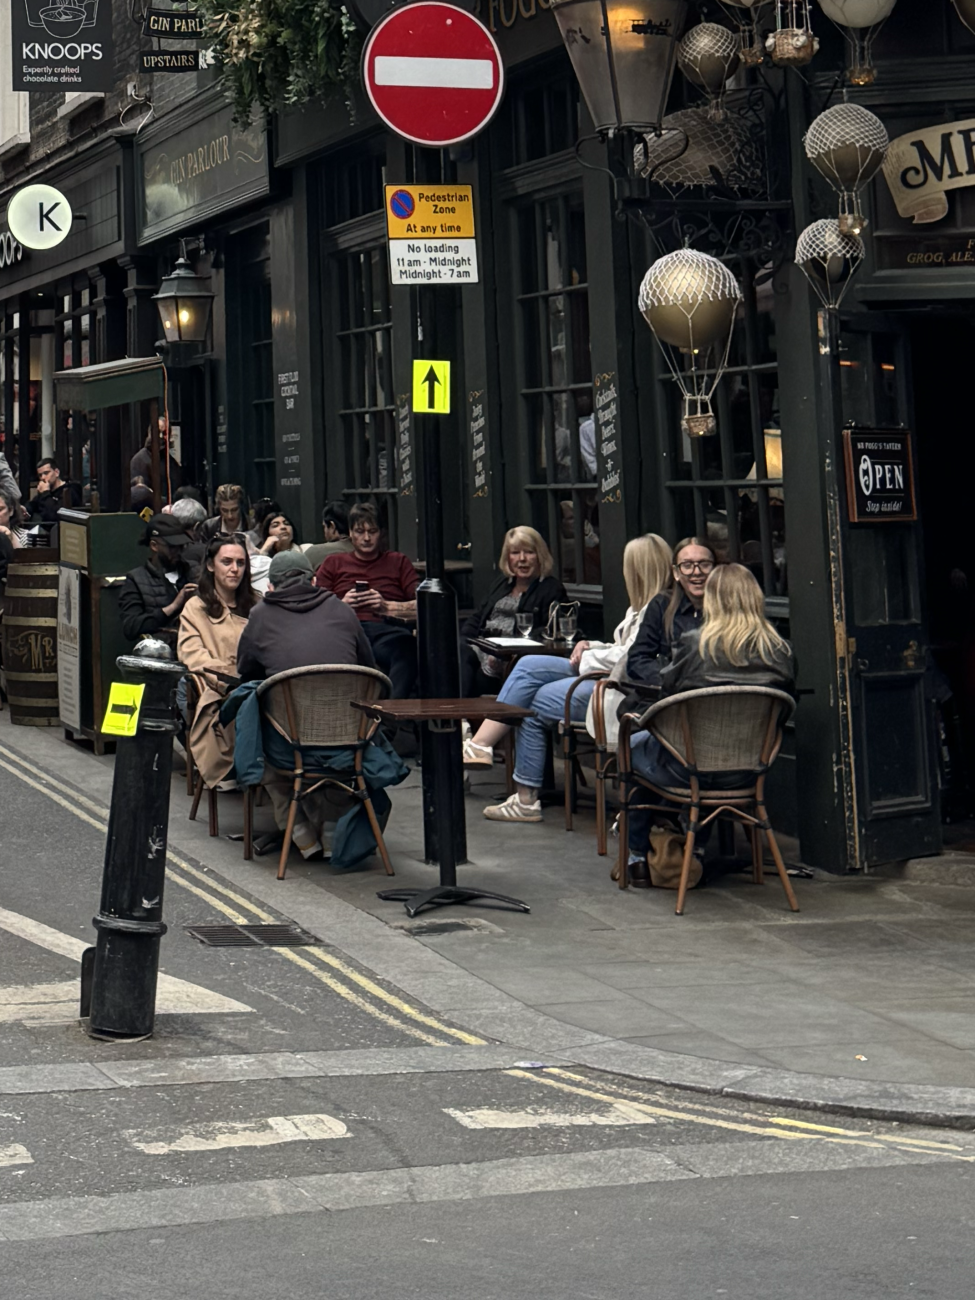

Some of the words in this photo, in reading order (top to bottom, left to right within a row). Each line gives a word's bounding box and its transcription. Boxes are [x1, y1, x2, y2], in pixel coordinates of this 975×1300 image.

[149, 15, 171, 32] GIN
[173, 18, 205, 33] PARL
[22, 42, 103, 60] KNOOPS
[143, 54, 195, 68] UPSTAIRS
[22, 65, 53, 75] Expertly
[53, 65, 80, 74] crafted
[22, 74, 59, 83] chocolate
[59, 74, 82, 83] drinks
[170, 156, 186, 187] GIN
[187, 134, 230, 179] PARLOUR
[418, 192, 469, 202] Pedestrian
[432, 204, 456, 214] Zone
[38, 201, 63, 232] K
[406, 223, 417, 233] At
[420, 224, 437, 234] any
[440, 223, 462, 233] time
[407, 243, 421, 253] No
[424, 243, 460, 254] loading
[429, 257, 472, 268] Midnight
[399, 269, 442, 280] Midnight
[858, 454, 904, 496] OPEN
